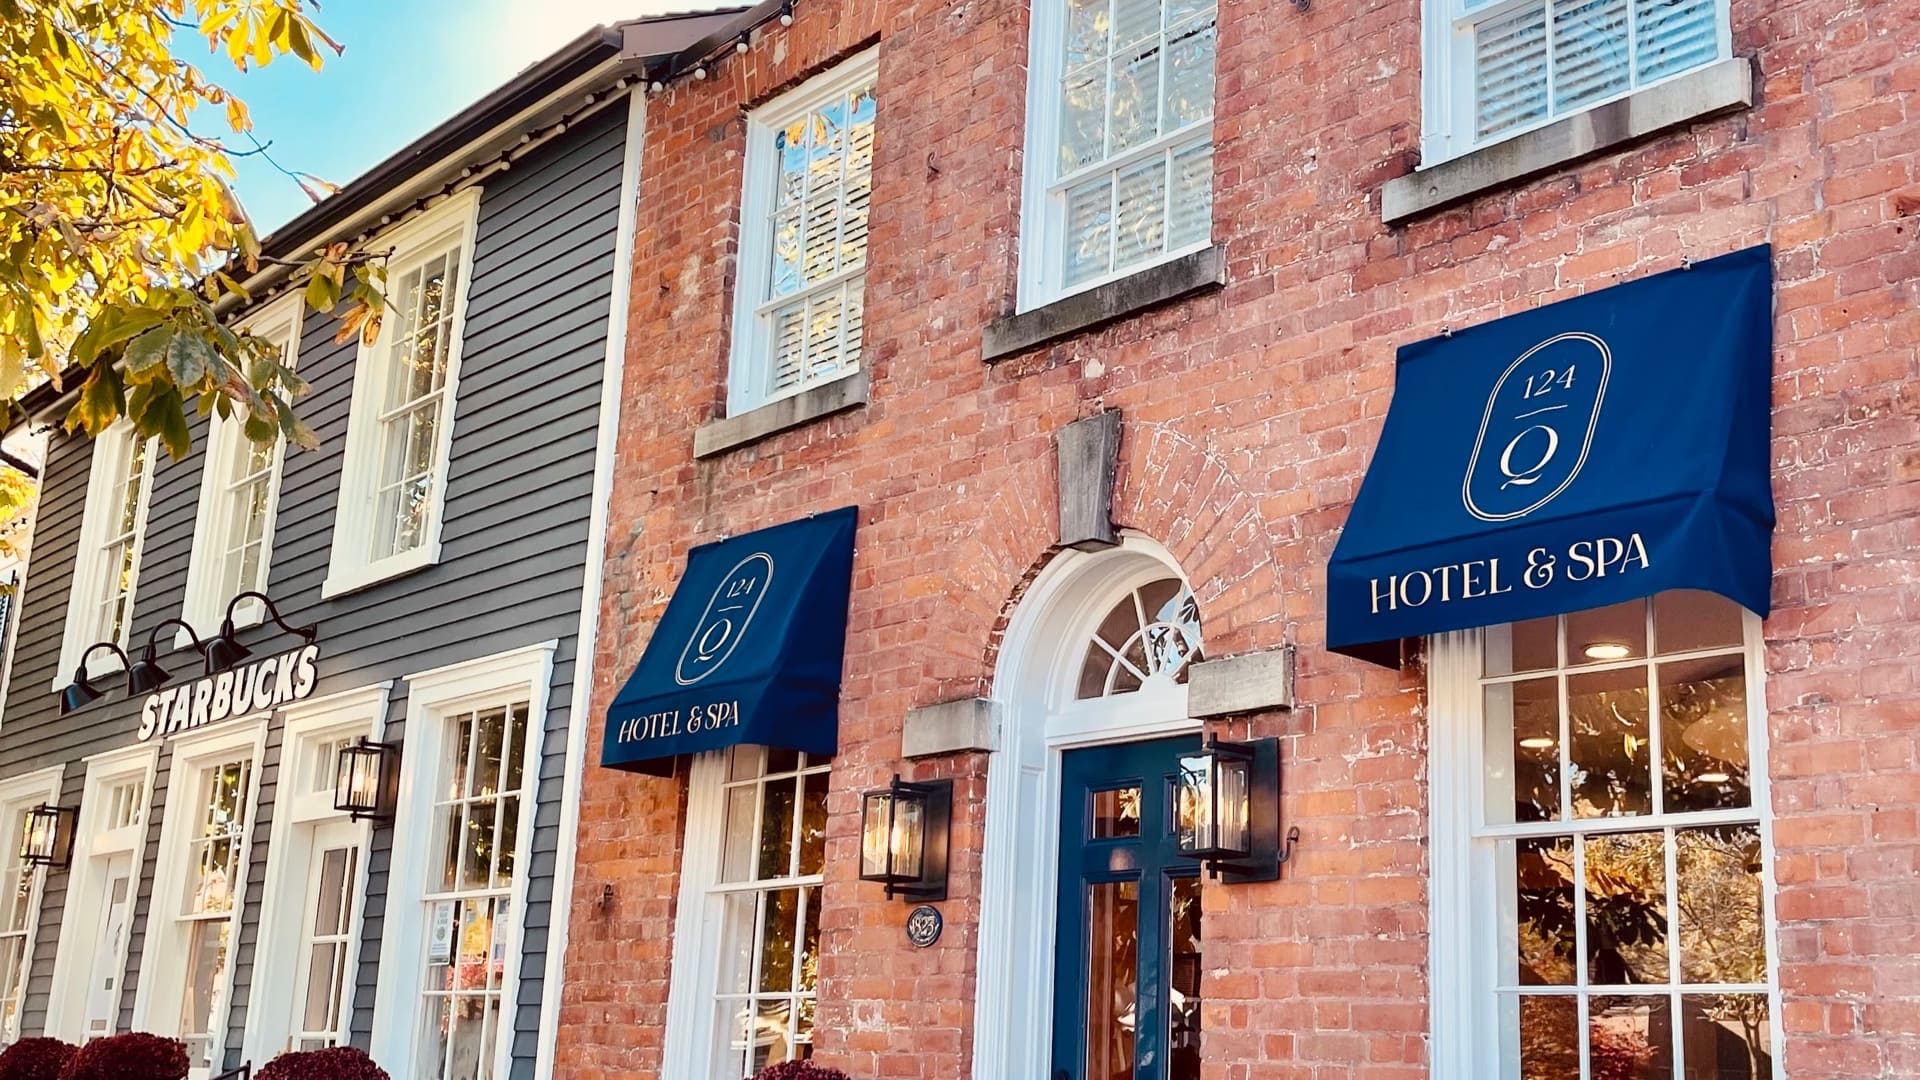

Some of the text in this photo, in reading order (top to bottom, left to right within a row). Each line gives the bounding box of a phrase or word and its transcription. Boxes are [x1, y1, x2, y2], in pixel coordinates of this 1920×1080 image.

[1523, 365, 1576, 399] 124
[1499, 424, 1559, 490] Q
[726, 577, 757, 598] 124
[1370, 533, 1650, 614] HOTEL & SPA
[693, 618, 731, 662] Q
[137, 645, 319, 742] STARBUCKS
[618, 700, 740, 744] HOTEL & SPA
